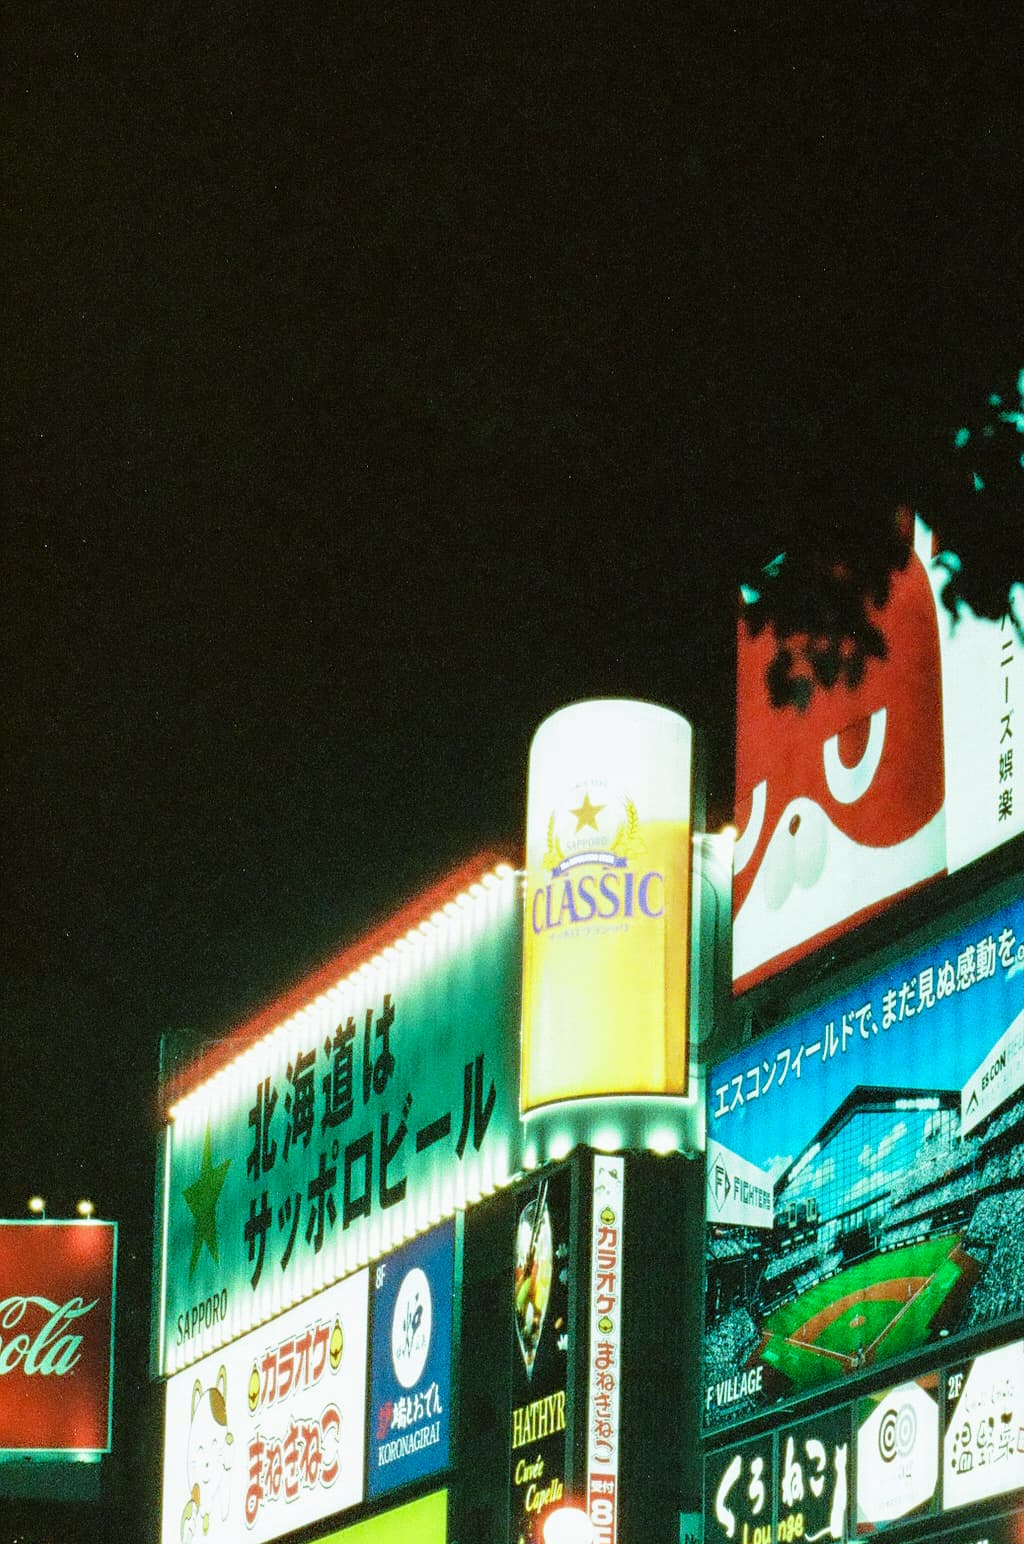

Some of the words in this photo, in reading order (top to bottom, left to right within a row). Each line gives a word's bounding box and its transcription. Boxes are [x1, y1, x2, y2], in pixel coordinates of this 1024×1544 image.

[532, 871, 664, 935] CLASSIC
[247, 993, 396, 1181] 北海道は
[244, 1053, 496, 1291] サッポロビール
[597, 1226, 617, 1315] カラオケ
[0, 1296, 99, 1376] ola
[176, 1288, 228, 1346] SAPPORO
[260, 1326, 330, 1405] カラオケ
[594, 1340, 615, 1463] まねきねこ
[716, 1366, 763, 1404] VILLAGE
[948, 1373, 963, 1400] 2F
[246, 1407, 341, 1525] まねきねこ
[378, 1421, 441, 1466] KORONAGIRAI
